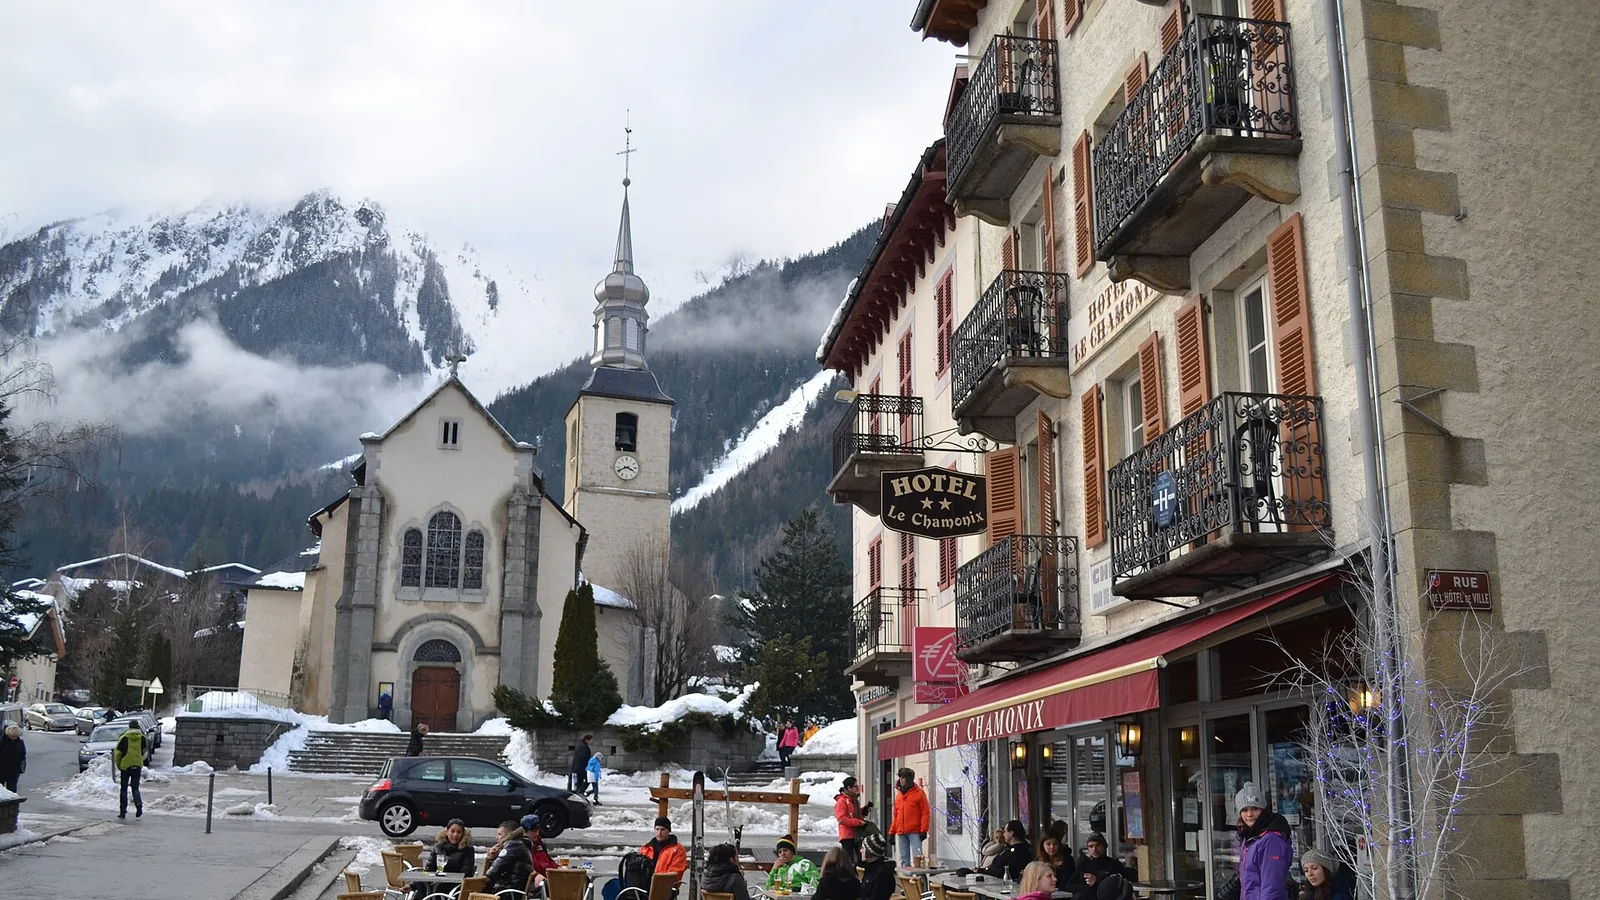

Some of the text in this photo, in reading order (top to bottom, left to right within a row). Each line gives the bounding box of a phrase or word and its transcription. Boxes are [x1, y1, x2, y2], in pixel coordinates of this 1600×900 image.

[1088, 281, 1127, 326] HOTEL
[1074, 336, 1087, 364] LE
[891, 473, 978, 501] HOTEL
[887, 504, 985, 530] Le Chamonix
[1453, 577, 1478, 588] RUE
[1473, 593, 1489, 603] VILLE
[919, 700, 1045, 752] BAR LE CHAMONIX
